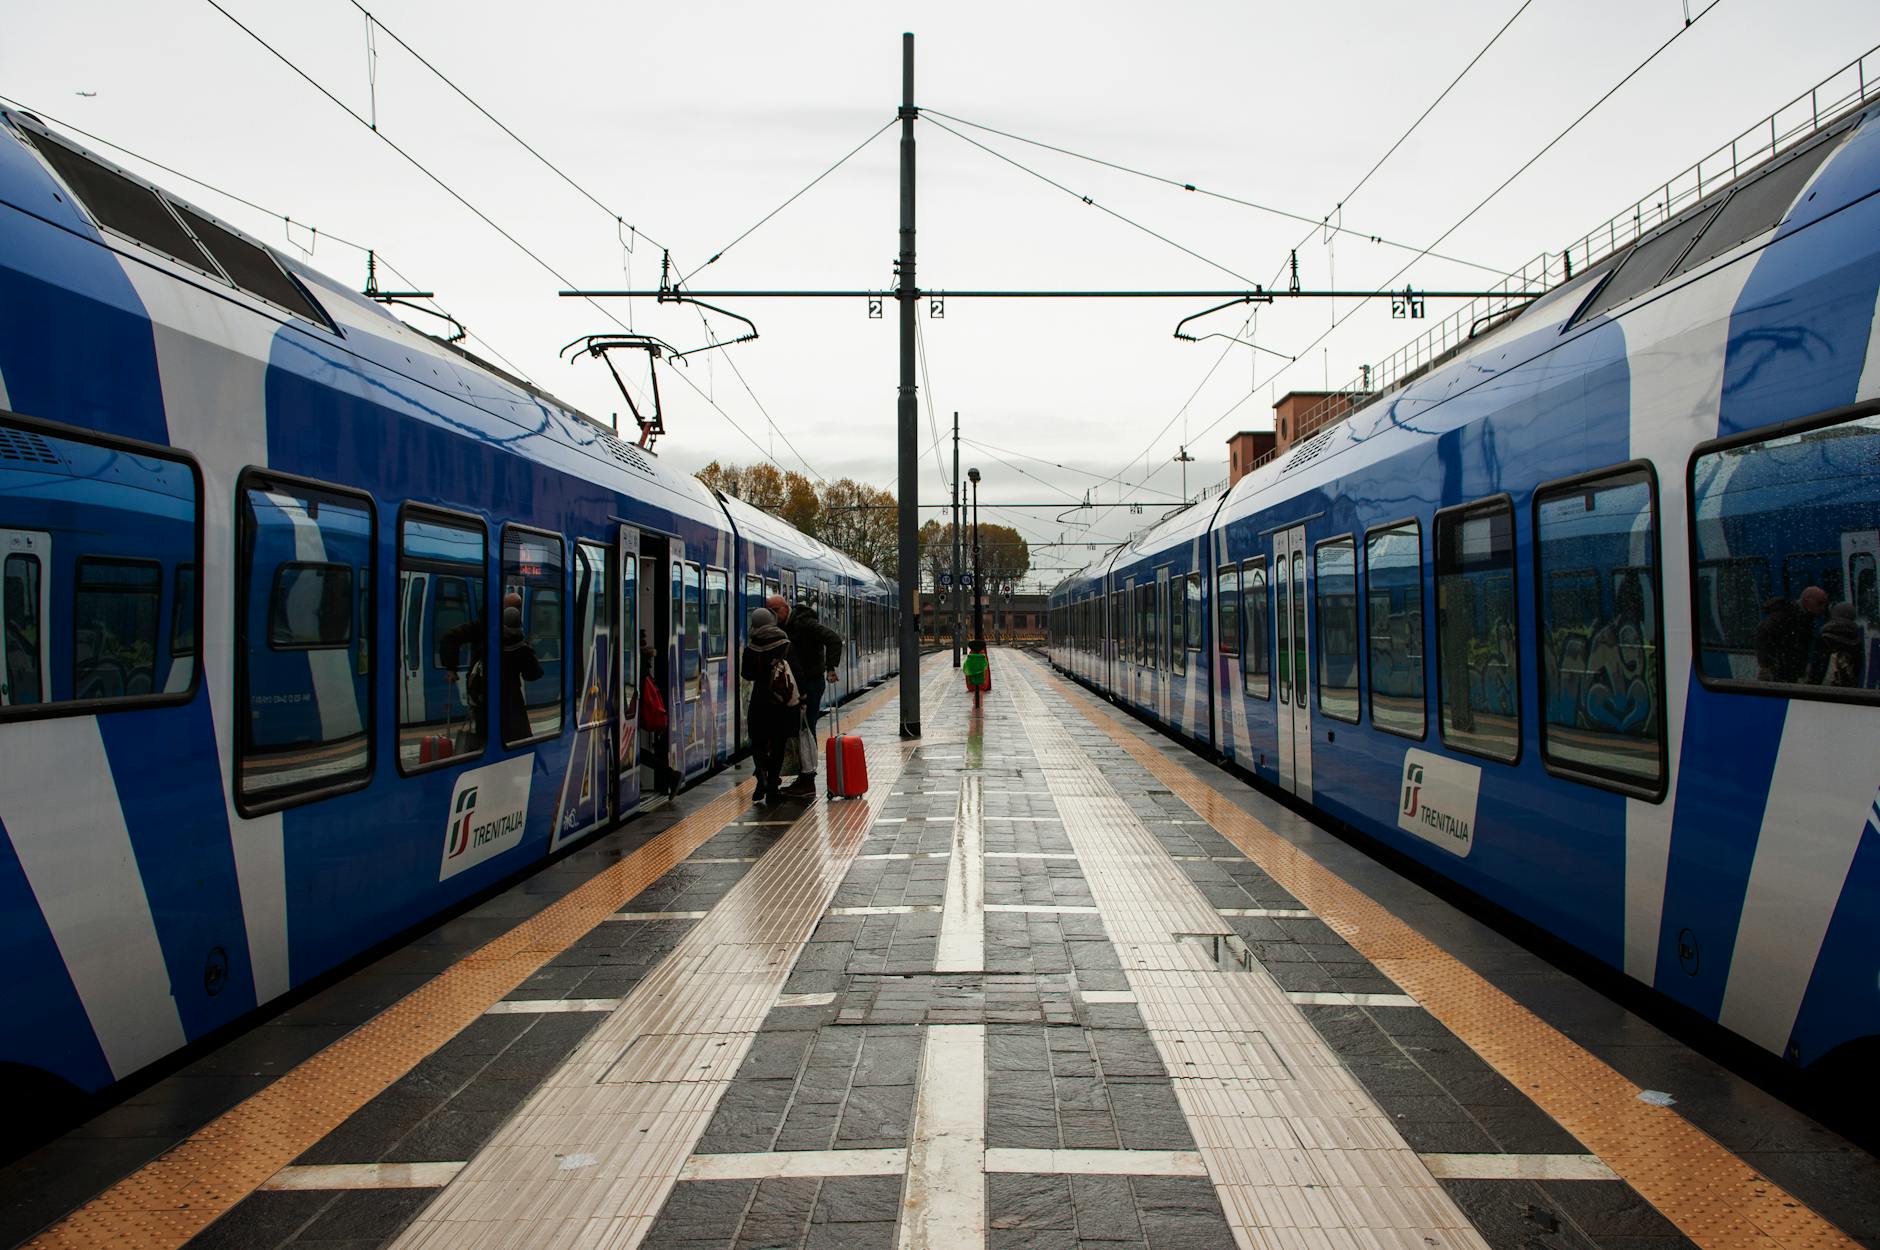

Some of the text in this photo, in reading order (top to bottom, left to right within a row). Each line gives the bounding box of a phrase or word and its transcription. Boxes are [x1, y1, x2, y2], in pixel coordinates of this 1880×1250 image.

[869, 301, 882, 317] 2
[931, 301, 944, 317] 2
[473, 811, 523, 849] TRENITALIA
[1421, 805, 1469, 842] TRENITALIA
